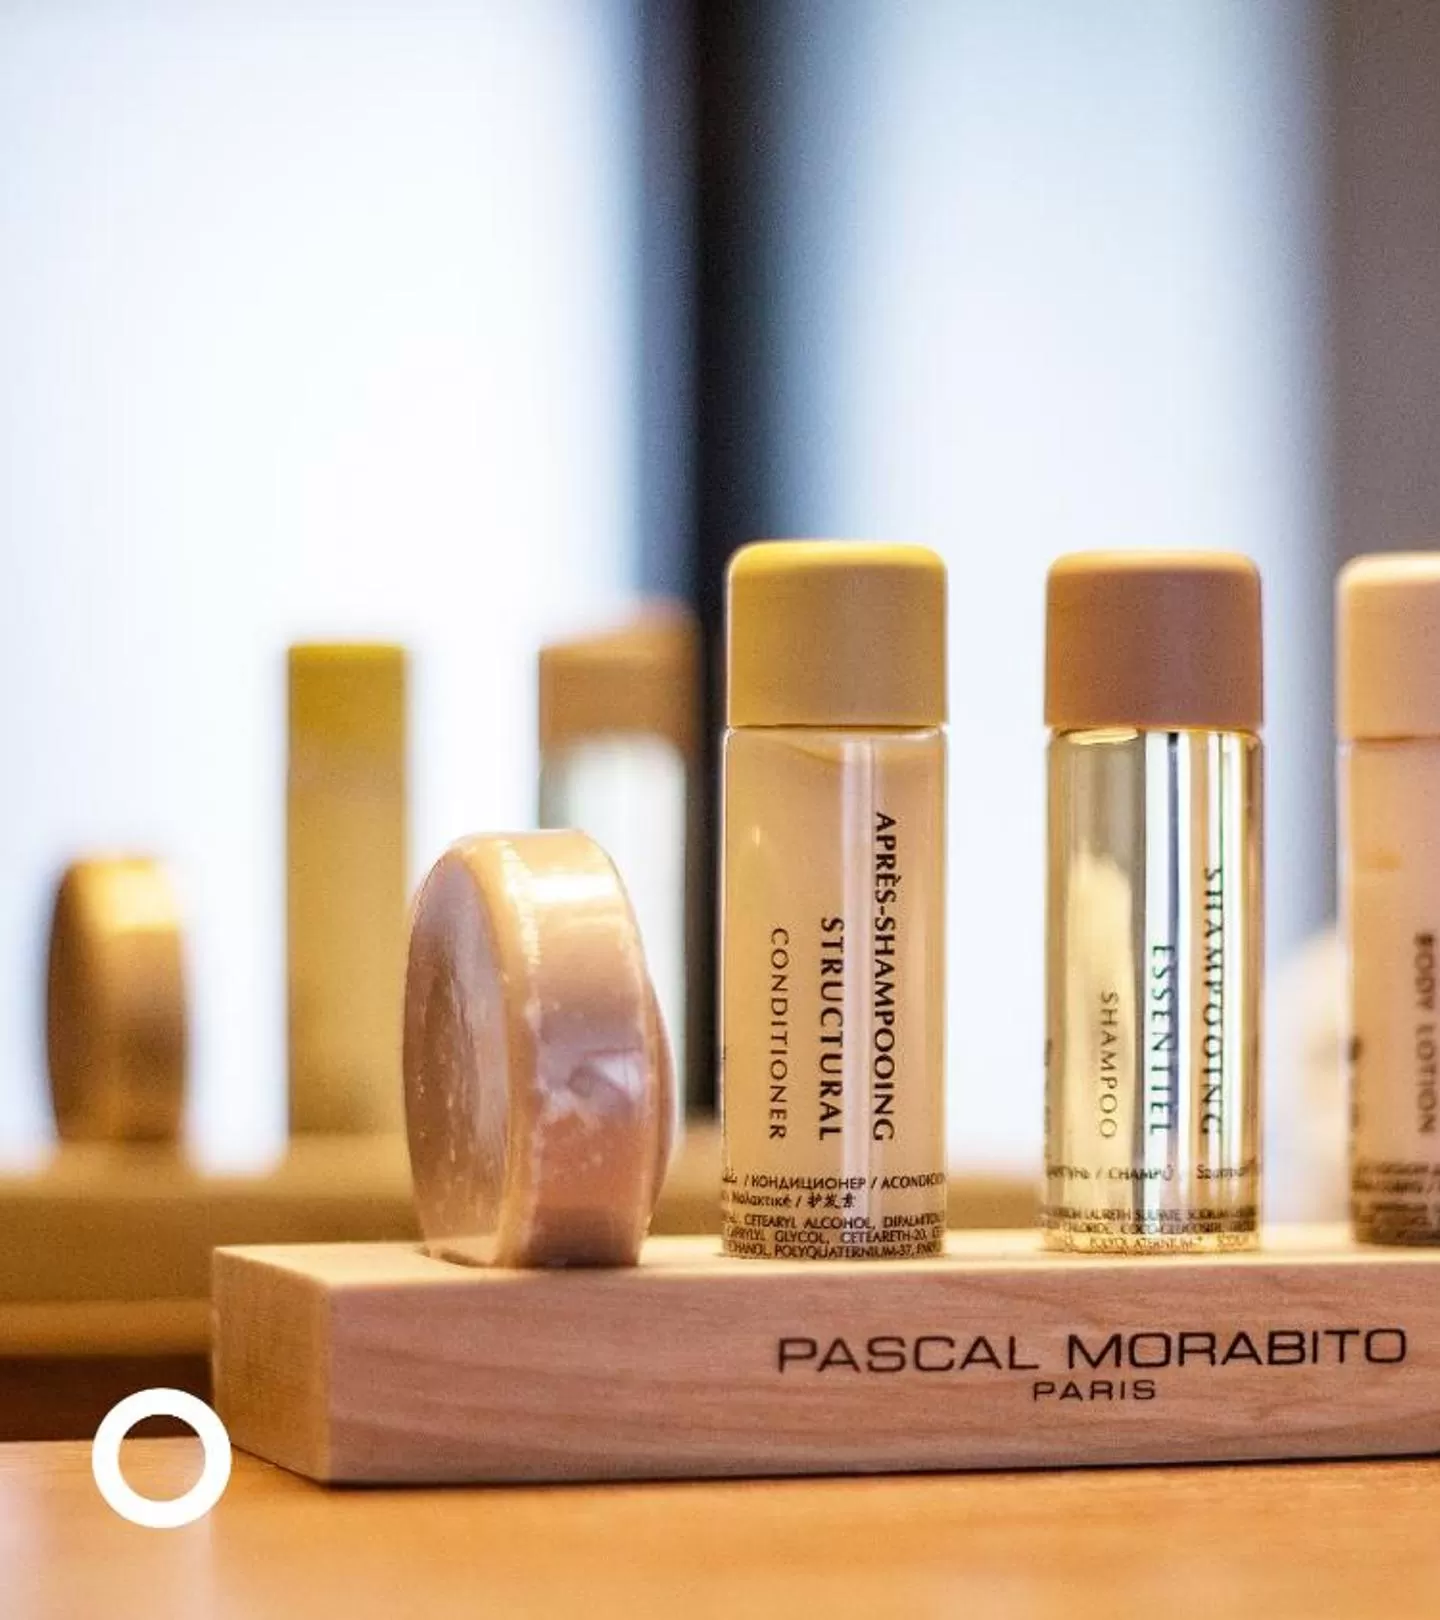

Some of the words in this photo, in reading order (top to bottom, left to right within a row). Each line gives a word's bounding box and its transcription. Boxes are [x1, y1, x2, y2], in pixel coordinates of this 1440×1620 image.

[872, 812, 902, 1141] APRÈS-SHAMPOOING
[1415, 932, 1436, 1010] BODY
[769, 928, 790, 1140] CONDITIONER
[819, 917, 845, 1141] STRUCTURAL
[1099, 991, 1119, 1139] SHAMPOO
[1150, 945, 1176, 1136] ESSENTIEL
[1416, 1025, 1438, 1135] LOTION
[751, 1174, 866, 1190] КОНДИЦИОНЕР
[774, 1229, 830, 1245] GLYCOL,
[777, 1335, 1040, 1373] PASCAL
[1067, 1328, 1408, 1369] MORABITO
[1033, 1379, 1156, 1401] PARIS
